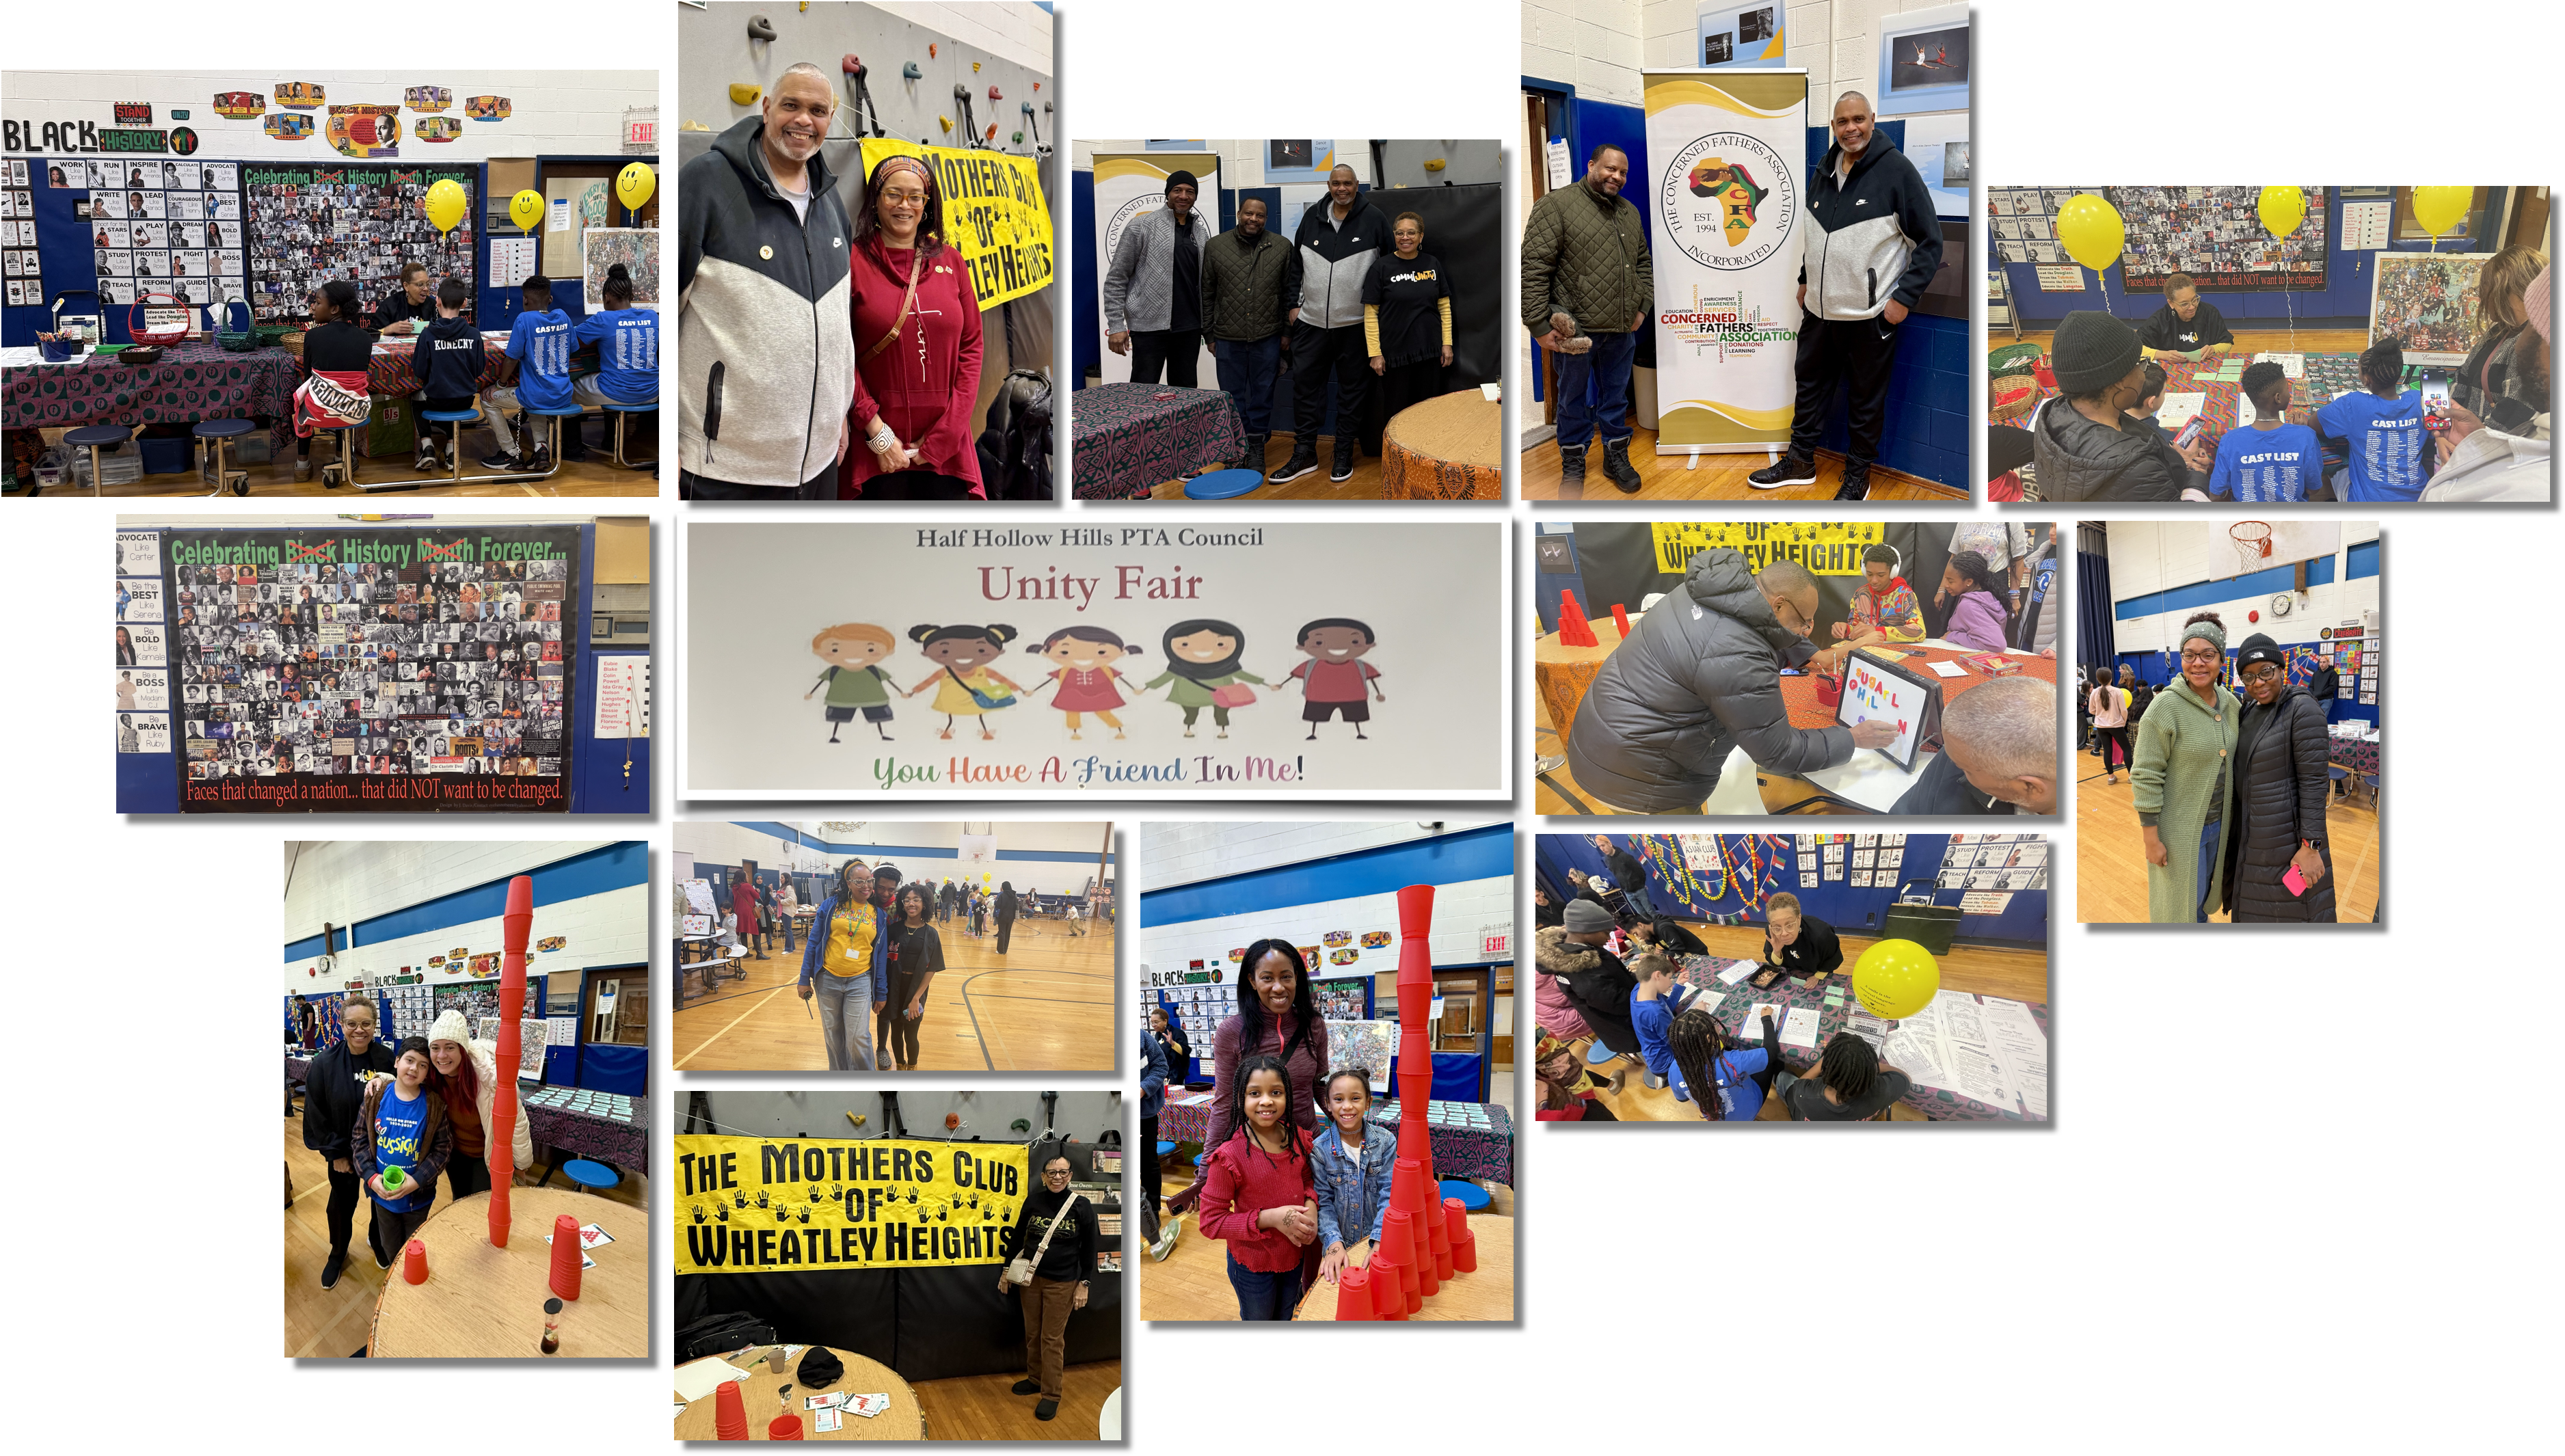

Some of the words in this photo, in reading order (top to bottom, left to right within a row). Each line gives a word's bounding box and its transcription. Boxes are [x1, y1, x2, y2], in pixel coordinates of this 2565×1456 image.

[330, 106, 359, 114] BLACK
[362, 106, 400, 114] HISTORY
[3, 120, 98, 152] BLACK
[632, 124, 653, 141] EXIT
[1712, 136, 1765, 156] FATHERS
[245, 168, 310, 188] Celebrating
[348, 170, 386, 188] History
[922, 153, 1010, 201] MOTHERS
[1666, 141, 1709, 206] CONCERNED
[1764, 154, 1790, 232] ASSOCIATION
[973, 206, 995, 248] OF
[1110, 200, 1144, 247] CONCERNED
[1667, 208, 1682, 233] THE
[1694, 213, 1714, 221] EST.
[1687, 243, 1771, 266] INCORPORATED
[999, 243, 1051, 292] HEIGHTS
[2243, 274, 2259, 285] NOT
[2261, 275, 2275, 284] want
[2295, 273, 2324, 287] changed.
[1661, 314, 1736, 324] CONCERNED
[1700, 323, 1753, 333] FATHERS
[435, 339, 474, 350] KONECNY
[1719, 332, 1798, 342] ASSOCIATION
[2422, 354, 2464, 362] Emancipation
[2399, 418, 2417, 427] LIST
[916, 529, 967, 548] Half
[972, 529, 1052, 547] Hollow
[1060, 528, 1112, 546] Hills
[1120, 528, 1171, 545] PTA
[1178, 528, 1263, 545] Council
[172, 539, 279, 569] Celebrating
[286, 541, 337, 563] Black
[344, 540, 411, 569] History
[417, 538, 474, 561] Month
[481, 537, 566, 561] Forever...
[132, 591, 158, 599] BEST
[977, 565, 1100, 612] Unity
[1114, 565, 1203, 600] Fair
[874, 757, 941, 790] You
[947, 757, 1032, 783] Have
[1038, 756, 1066, 783] A
[1073, 756, 1187, 783] Friend
[1194, 756, 1240, 783] In
[1246, 756, 1304, 783] Me!
[187, 780, 218, 800] Faces
[222, 780, 245, 800] that
[248, 779, 298, 807] changed
[301, 785, 308, 798] a
[311, 781, 358, 798] nation...
[362, 779, 384, 798] that
[388, 779, 407, 798] did
[411, 779, 440, 798] NOT
[444, 781, 474, 798] want
[477, 781, 488, 798] to
[492, 778, 505, 798] be
[509, 778, 563, 806] changed.
[1702, 845, 1716, 853] CLUB
[1486, 936, 1506, 952] EXIT
[375, 975, 397, 987] BLACK
[474, 982, 491, 992] History
[1152, 970, 1184, 986] BLACK
[1334, 982, 1364, 991] Forever...
[680, 1152, 737, 1196] THE
[762, 1144, 934, 1185] MOTHERS
[954, 1151, 1018, 1196] CLUB
[846, 1188, 883, 1222] OF
[688, 1226, 878, 1266] WHEATLEY
[886, 1223, 1016, 1261] HEIGHTS
